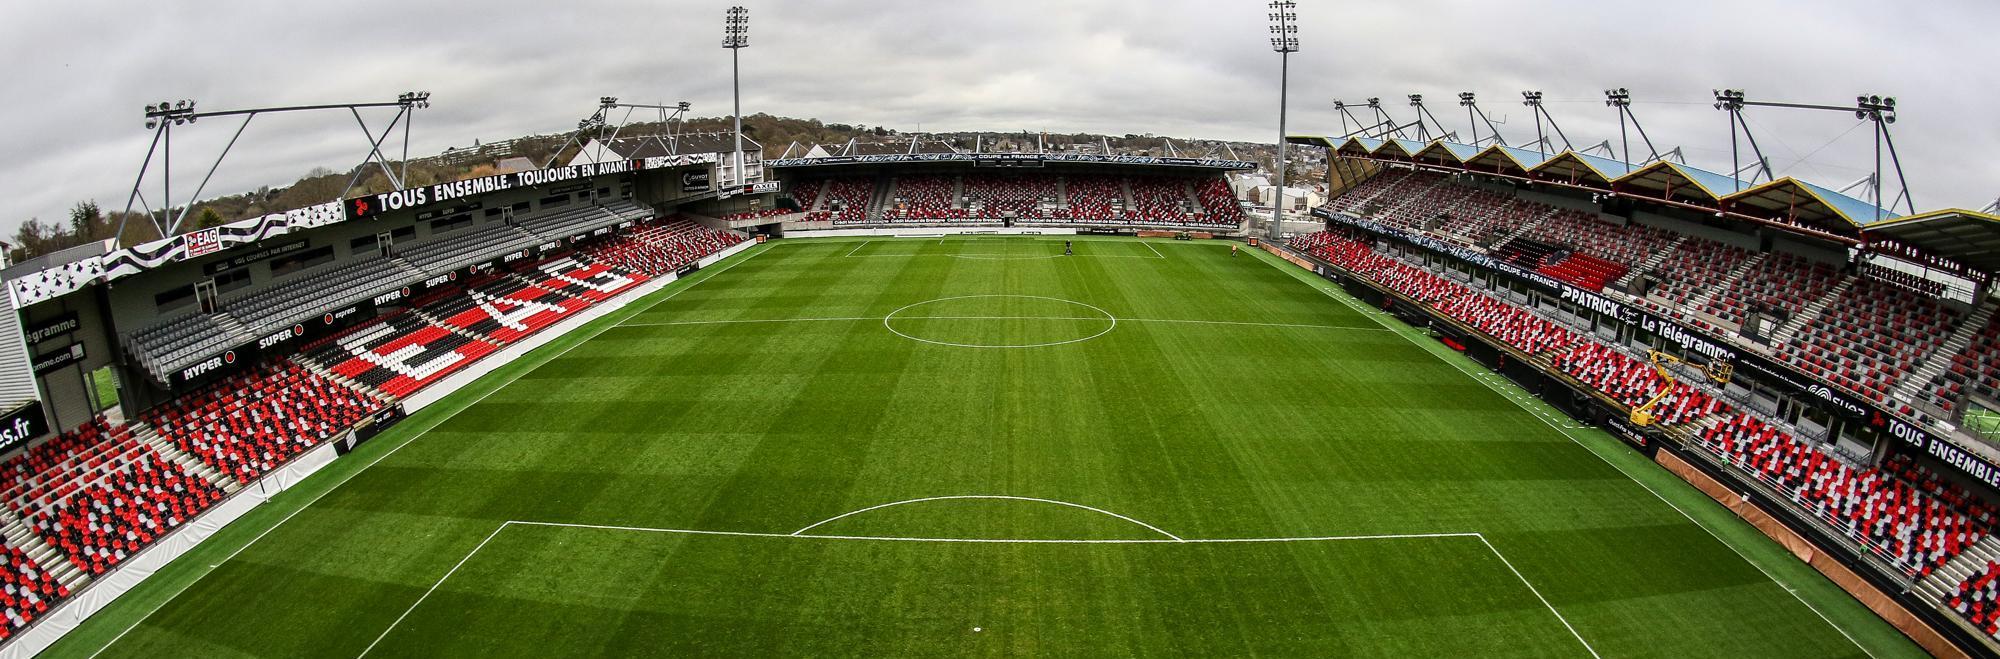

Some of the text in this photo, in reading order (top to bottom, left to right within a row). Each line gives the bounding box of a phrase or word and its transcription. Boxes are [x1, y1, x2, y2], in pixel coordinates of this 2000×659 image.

[378, 187, 426, 212] TOUS
[434, 174, 511, 201] ENSEMBLE,
[517, 165, 578, 187] TOUJOURS
[582, 163, 595, 177] EN
[599, 160, 627, 175] AVANT
[197, 229, 217, 246] EAG
[539, 242, 556, 252] SUPER
[504, 251, 523, 263] HYPER
[425, 274, 448, 288] SUPER
[1499, 263, 1521, 276] COUPE
[1529, 273, 1559, 289] FRANCE
[374, 290, 401, 306] HYPER
[1571, 288, 1620, 319] PATRICK
[335, 306, 356, 319] express
[1641, 314, 1655, 332] Le
[259, 329, 292, 350] SUPER
[184, 357, 222, 381] HYPER
[1889, 419, 1924, 447] TOUS
